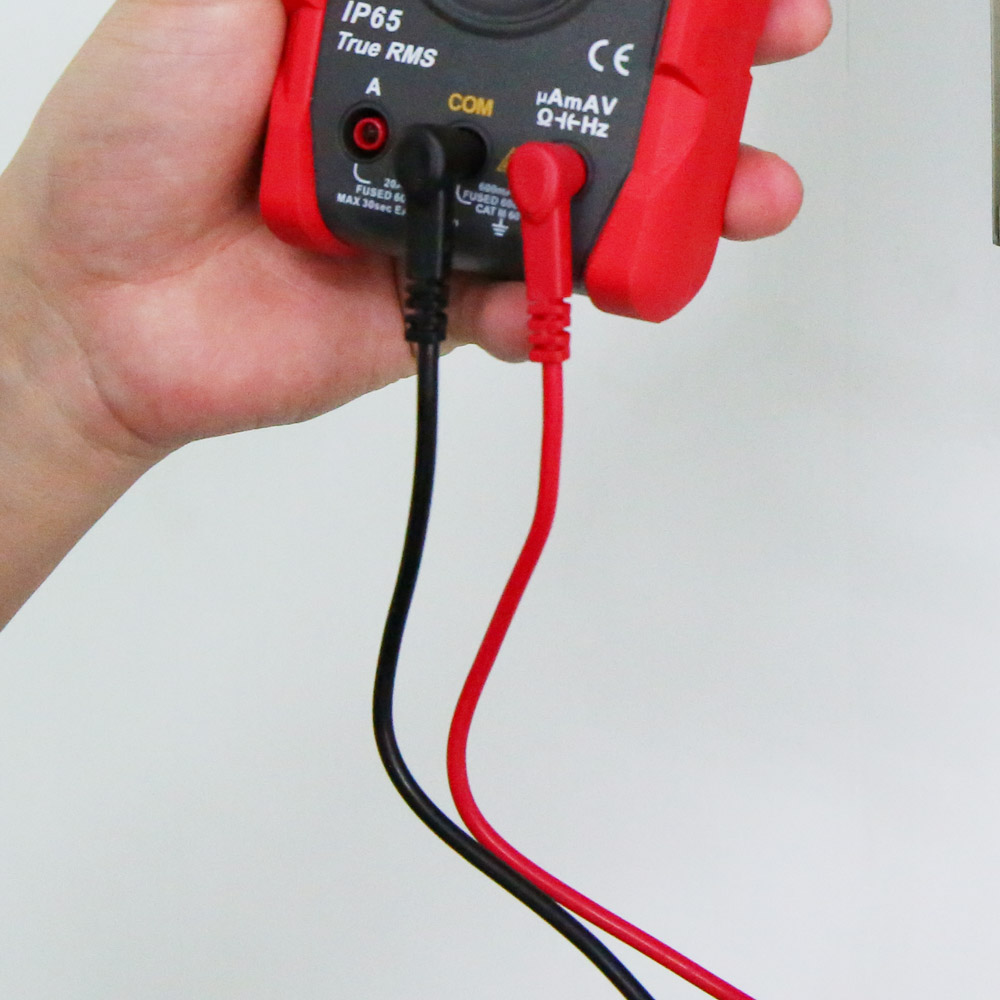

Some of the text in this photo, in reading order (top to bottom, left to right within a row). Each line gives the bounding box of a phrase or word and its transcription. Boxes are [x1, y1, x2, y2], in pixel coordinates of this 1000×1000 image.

[341, 0, 404, 32] IP65
[337, 31, 438, 68] True RMS
[588, 39, 634, 76] CE
[365, 77, 381, 96] A
[448, 92, 493, 117] COM
[336, 193, 361, 206] MAX
[356, 184, 393, 200] FUSED
[475, 203, 497, 216] CAT
